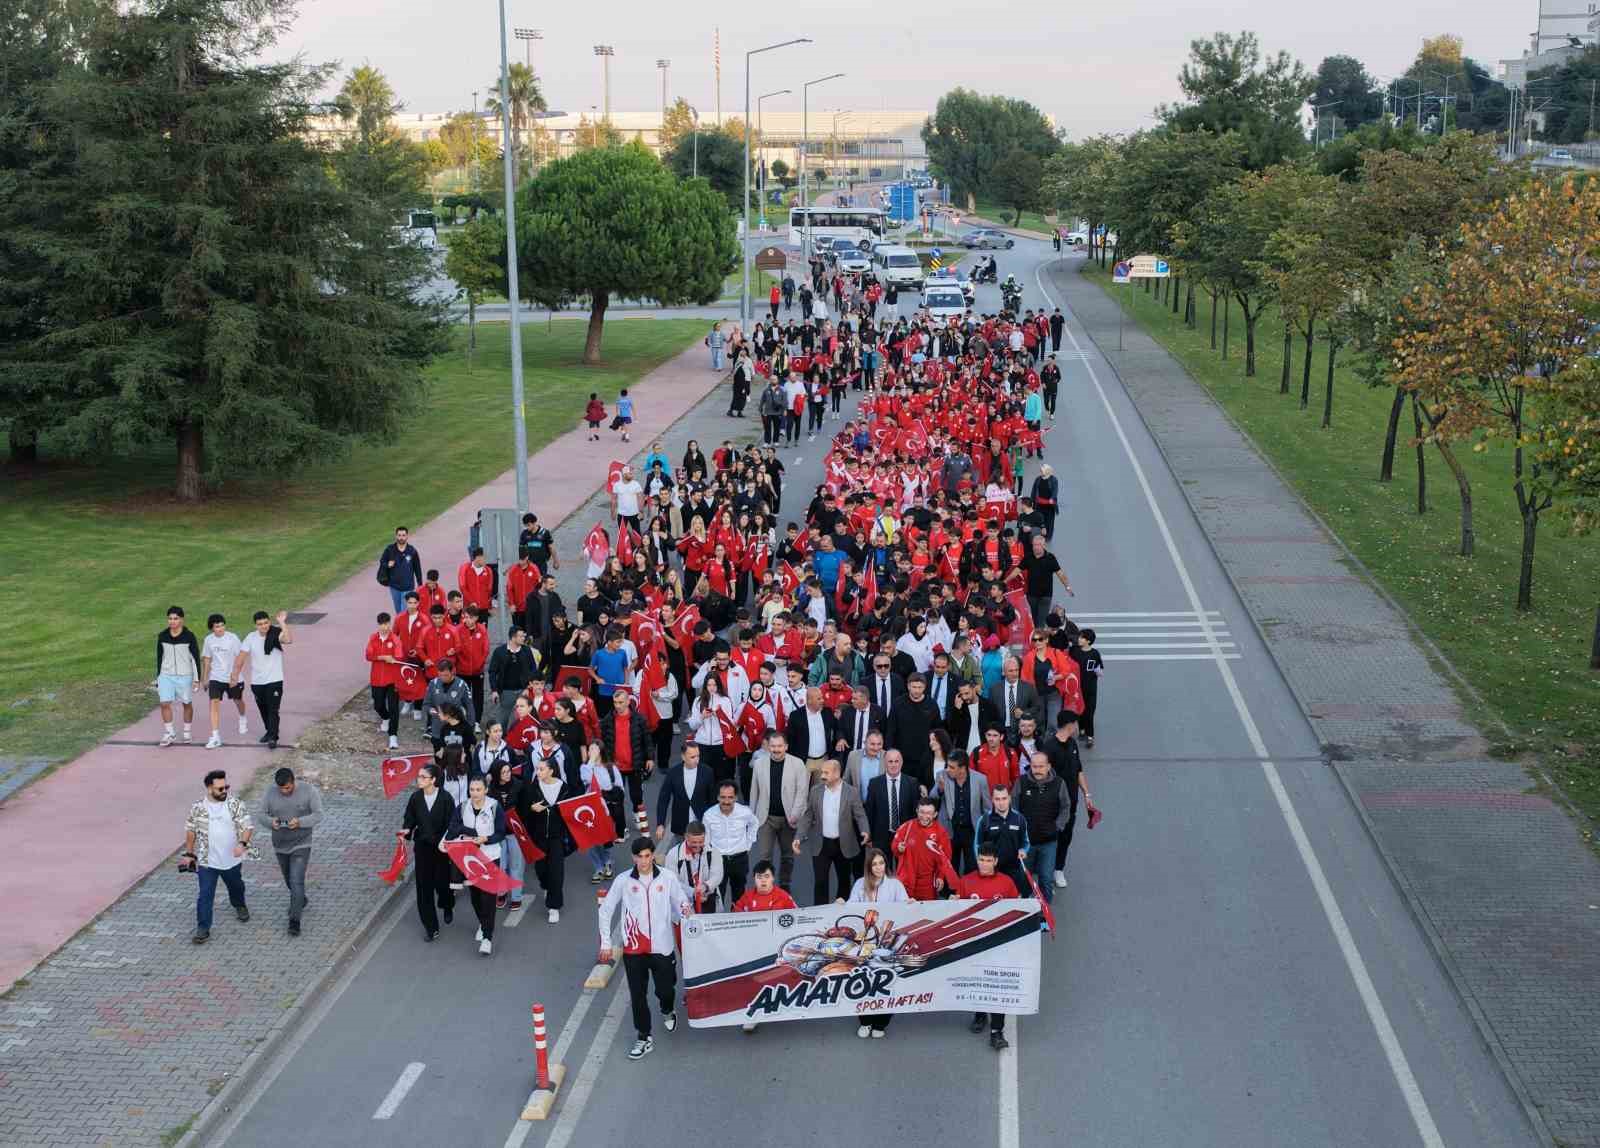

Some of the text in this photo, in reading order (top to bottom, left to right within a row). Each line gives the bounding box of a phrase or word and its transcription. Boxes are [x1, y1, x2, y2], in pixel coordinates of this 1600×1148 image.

[747, 967, 895, 1016] AMATÖR
[856, 992, 934, 1013] SPOR HAFTASI
